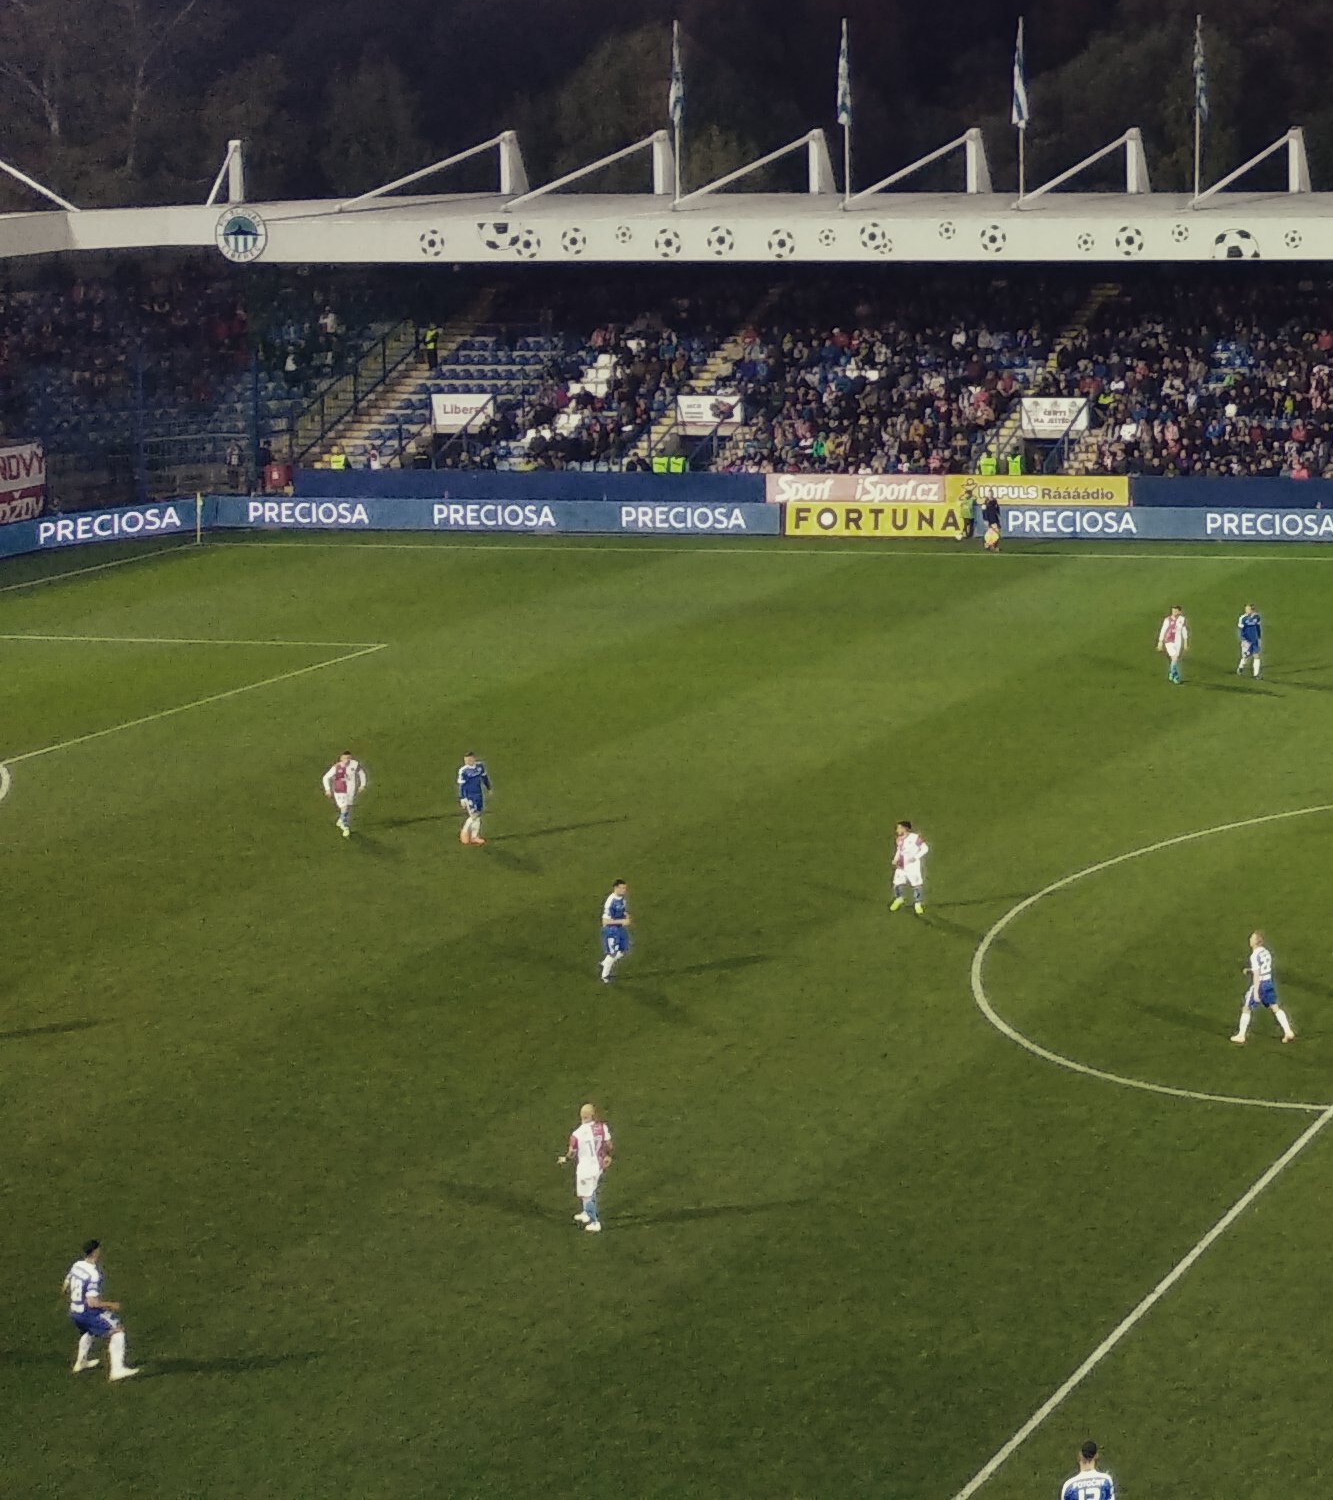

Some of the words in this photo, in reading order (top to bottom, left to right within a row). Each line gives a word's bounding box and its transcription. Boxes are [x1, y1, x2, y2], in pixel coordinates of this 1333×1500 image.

[775, 474, 834, 502] Sport
[855, 475, 939, 502] iSport.cz
[248, 501, 369, 524] PRECIOSA
[433, 504, 556, 527] PRECIOSA
[621, 506, 747, 529] PRECIOSA
[794, 507, 962, 532] FORTUNA
[1008, 510, 1137, 534] PRECIOSA
[39, 506, 181, 544] PRECIOSA
